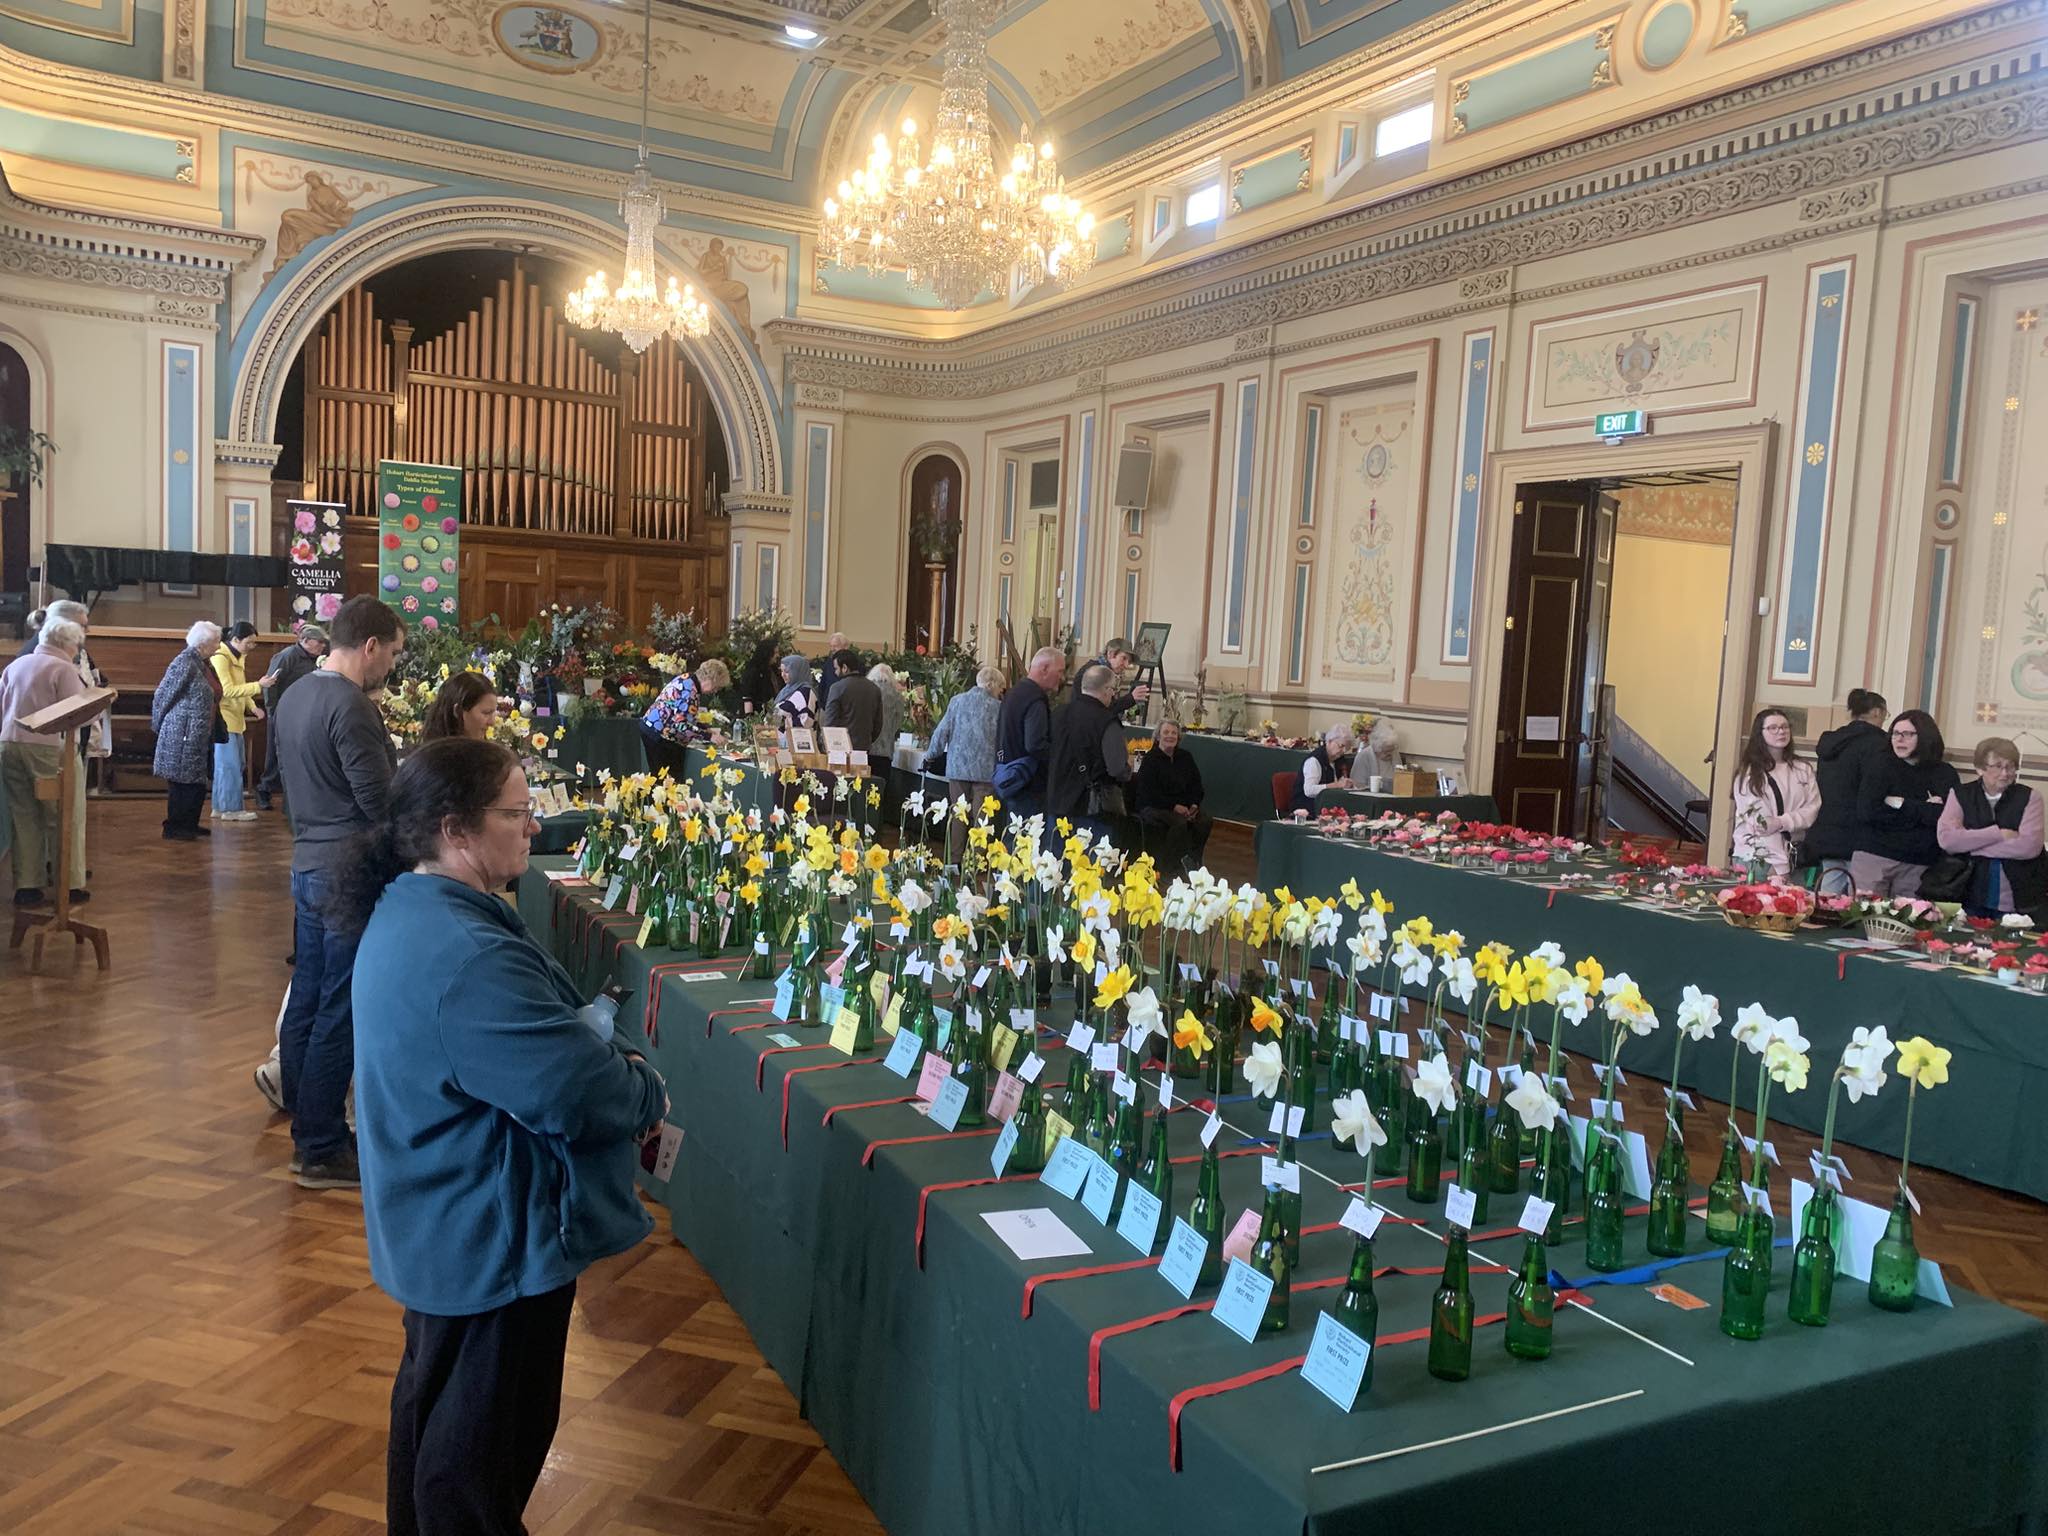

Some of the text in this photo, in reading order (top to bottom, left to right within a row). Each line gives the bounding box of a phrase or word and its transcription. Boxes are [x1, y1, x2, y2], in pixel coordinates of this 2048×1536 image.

[1603, 414, 1628, 432] EXIT
[397, 484, 414, 492] Types
[423, 486, 446, 494] Dahlias
[291, 568, 341, 579] CAMELLIA
[296, 577, 337, 587] SOCIETY
